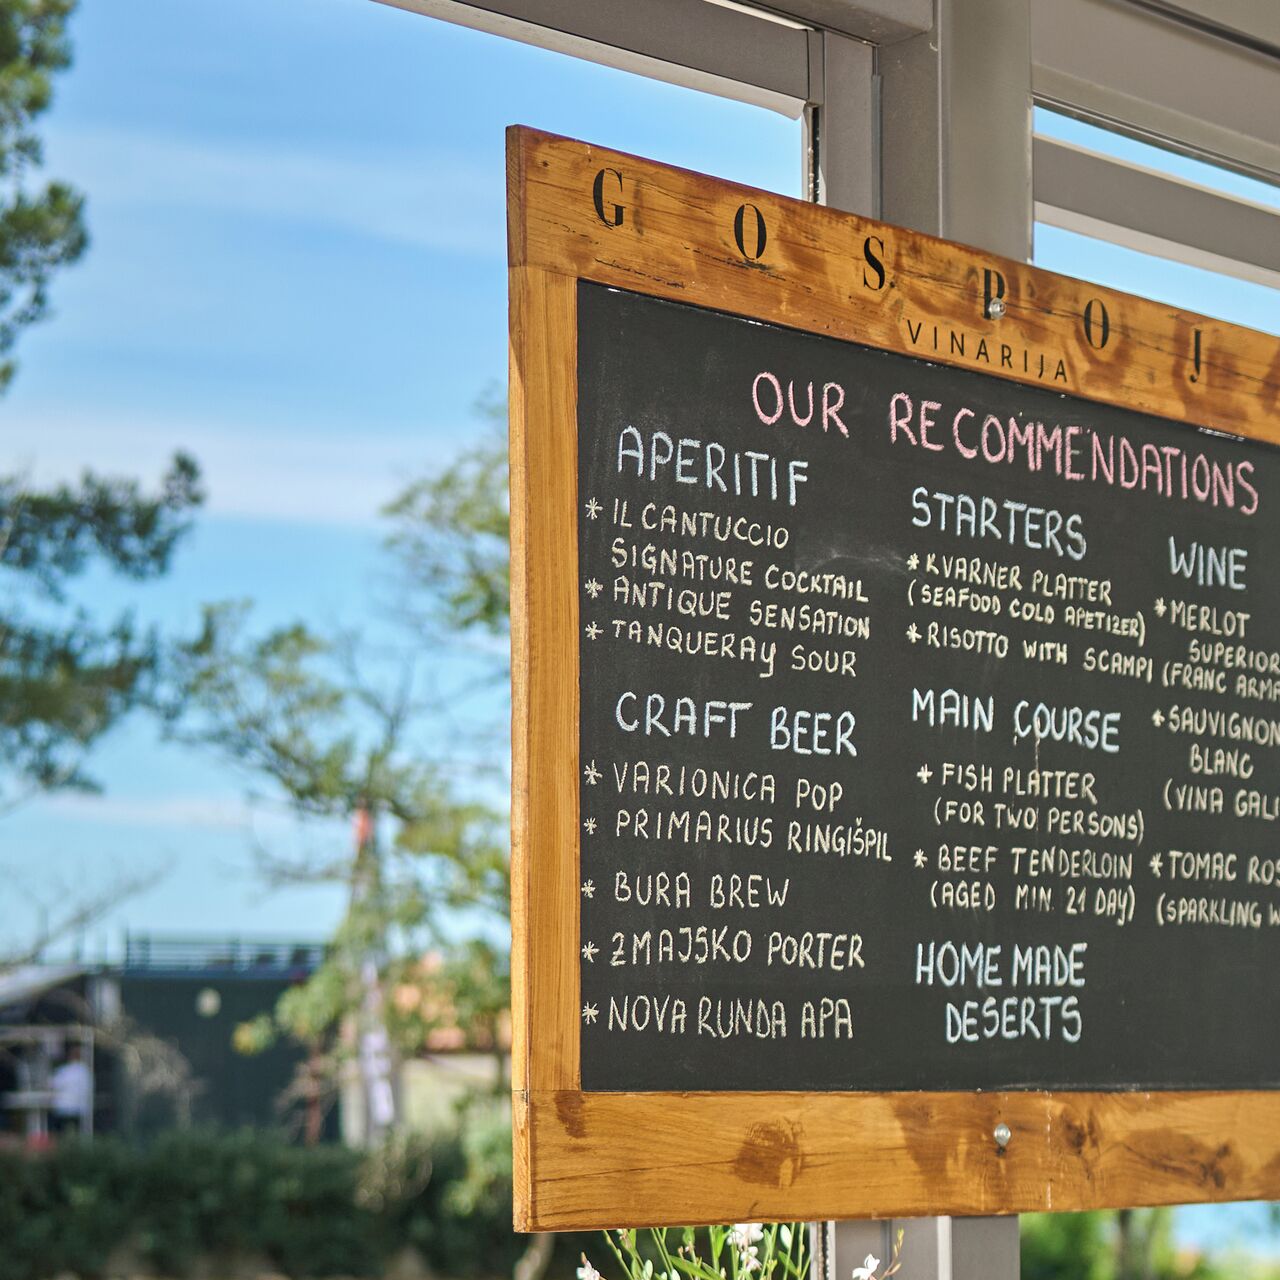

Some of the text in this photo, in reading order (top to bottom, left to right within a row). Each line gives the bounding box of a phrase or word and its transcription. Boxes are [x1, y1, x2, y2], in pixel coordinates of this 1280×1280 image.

[906, 319, 1069, 383] VINARIJA
[617, 425, 809, 506] APERITIF
[752, 371, 1259, 515] OUR RECOMMENDATIONS
[613, 498, 789, 549] IL CANTUCCIO
[912, 486, 1087, 561] STARTERS
[611, 537, 869, 603] SIGNATURE COCKTAIL
[925, 553, 1112, 607] KVARNER PLATTER
[1168, 535, 1248, 590] WINE
[613, 575, 870, 641] ANTIQUE SENSATION
[907, 578, 1001, 616] (SEAFOOD
[1009, 598, 1055, 624] COLD
[1170, 600, 1251, 638] MERLOT
[791, 644, 857, 678] SOUR
[927, 621, 1153, 684] RISOTTO WITH SCAMPI
[1189, 638, 1280, 675] SUPERIOR
[1162, 660, 1227, 694] (FRANC
[615, 691, 858, 757] CRAFT BEER
[912, 687, 1122, 754] MAIN COURSE
[942, 762, 1098, 805] FISH PLATTER
[1190, 743, 1254, 779] BLANC
[612, 761, 843, 812] VARIONICA POP
[615, 808, 774, 848] PRIMARIUS
[934, 797, 1145, 847] (FOR TWO PERSONS)
[938, 843, 1133, 880] BEEF TENDERLOIN
[1169, 850, 1238, 882] TOMAC
[615, 870, 790, 909] BURA BREW
[930, 880, 997, 912] (AGED
[1066, 886, 1087, 915] 21
[1157, 892, 1263, 929] (SPARKLING
[766, 931, 866, 971] PORTER
[915, 941, 1088, 987] HOME MADE
[608, 994, 854, 1039] NOVA RUNDA APA
[946, 995, 1083, 1044] DESERTS
